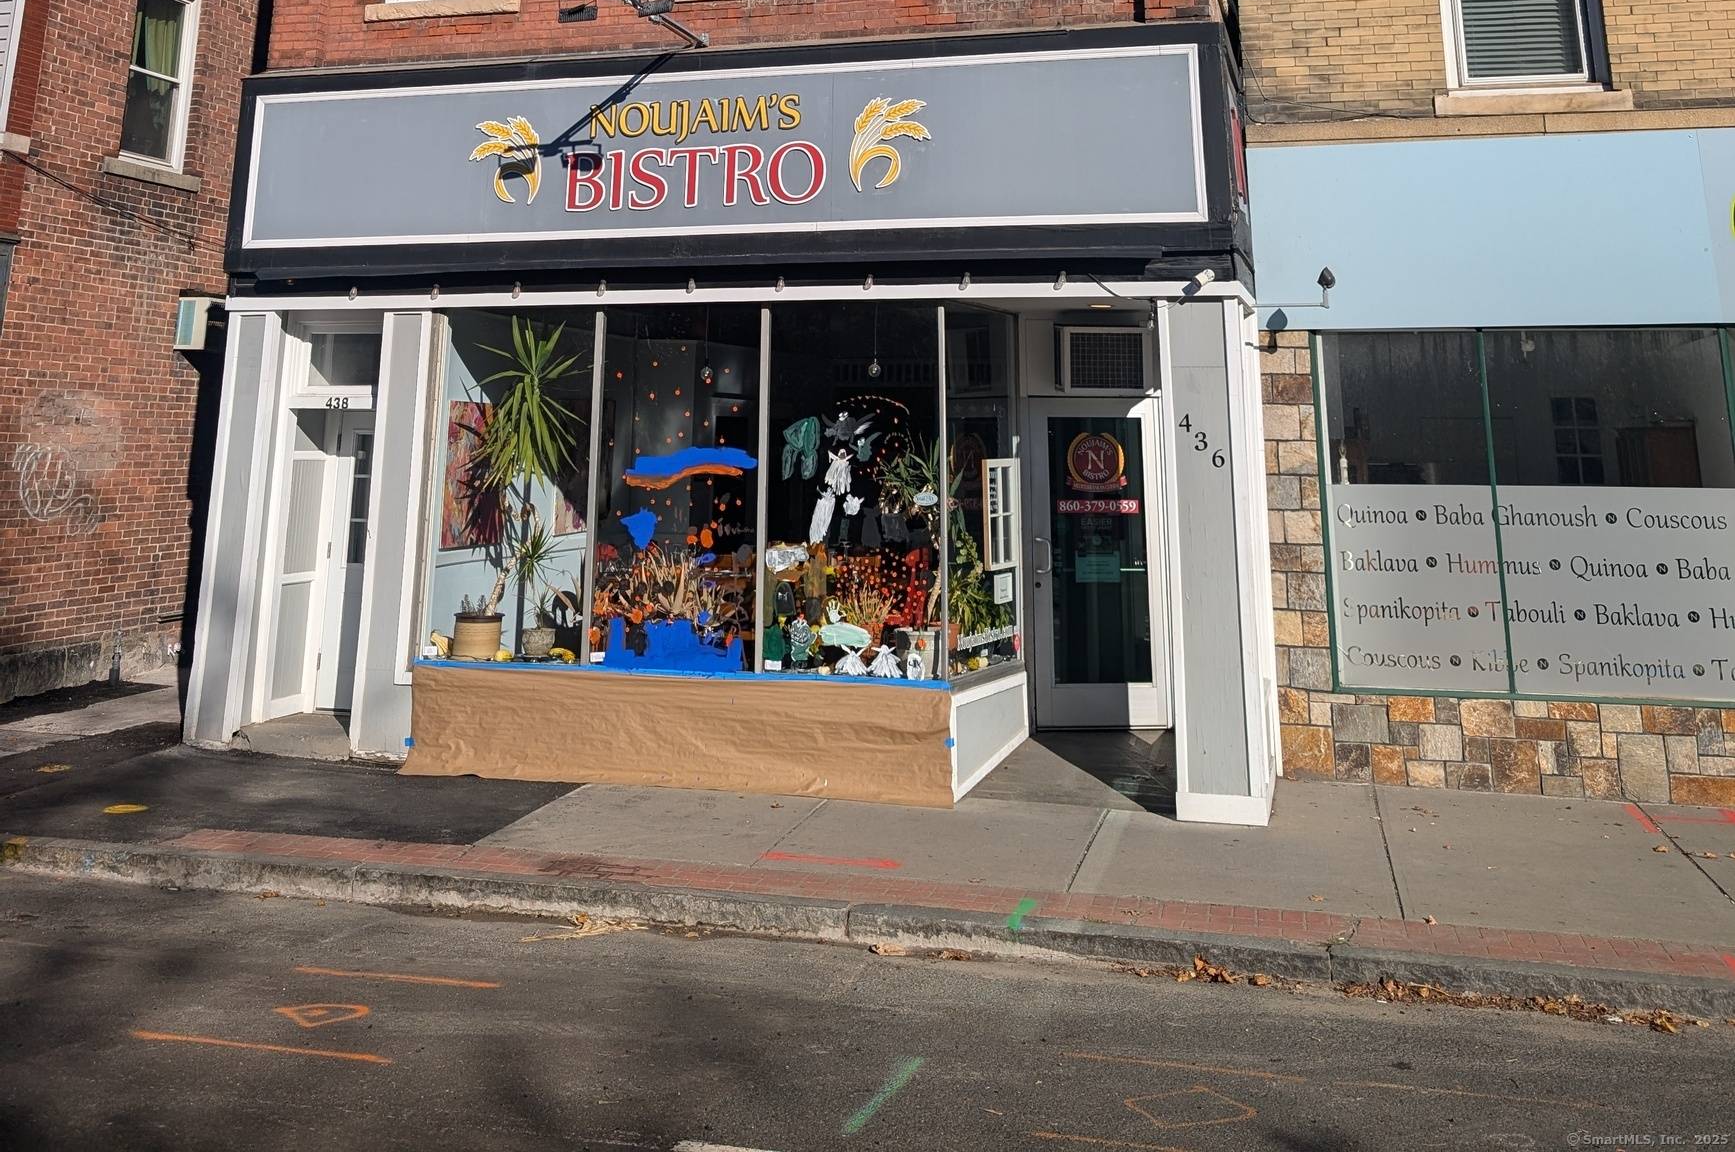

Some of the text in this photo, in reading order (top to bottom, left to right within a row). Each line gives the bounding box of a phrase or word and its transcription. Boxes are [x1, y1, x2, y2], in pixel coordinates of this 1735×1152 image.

[588, 93, 801, 144] NOUJAIM'S
[564, 140, 826, 213] BISTRO
[325, 397, 349, 409] 438
[1178, 413, 1225, 468] 436
[1086, 450, 1104, 469] N
[1059, 500, 1136, 512] 860-379-0559
[1337, 504, 1408, 528] Quinoa
[1433, 504, 1484, 525] Baba
[1492, 504, 1598, 528] Ghanoush
[1626, 508, 1727, 529] Couscous
[1340, 550, 1419, 572] Baklava
[1570, 556, 1648, 581] Quinoa
[1675, 558, 1730, 580] Baba
[1485, 600, 1566, 624] Tabouli
[1593, 603, 1680, 627] Baklava
[1348, 646, 1441, 669] Couscous
[1559, 654, 1685, 685] Spanikopita
